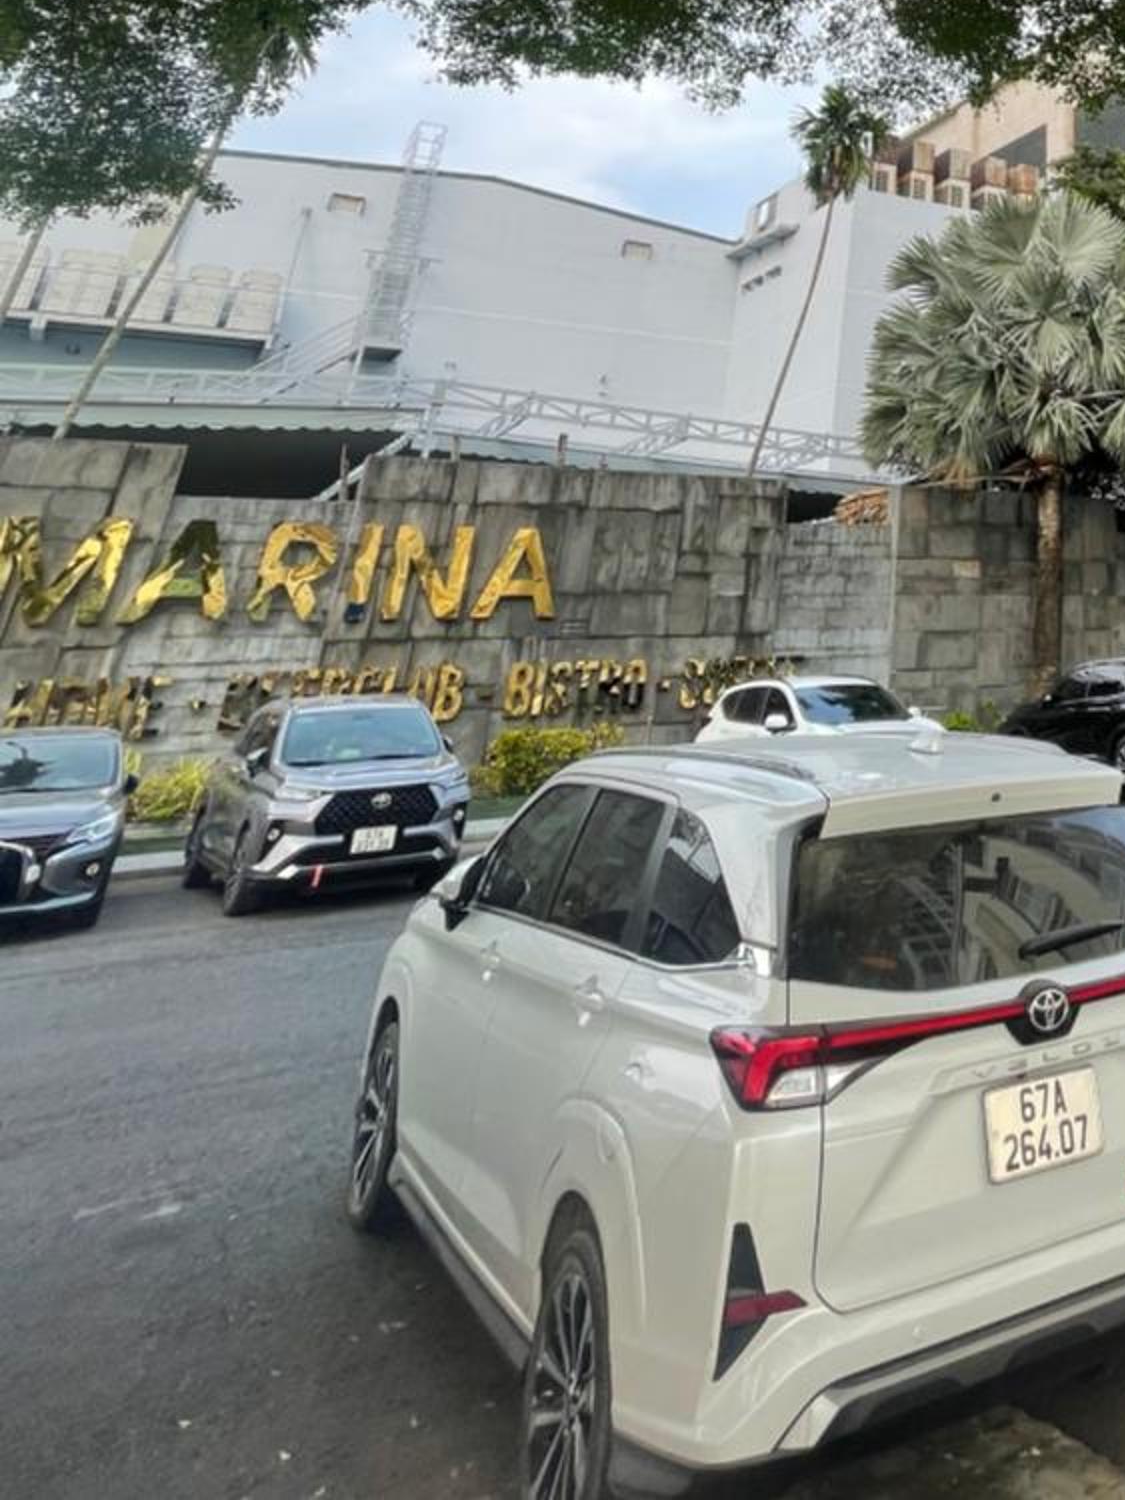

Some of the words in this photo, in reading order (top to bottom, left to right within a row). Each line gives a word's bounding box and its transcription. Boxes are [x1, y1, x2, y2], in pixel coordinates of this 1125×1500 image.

[0, 515, 557, 627] MARINA
[503, 657, 649, 718] BISTRO
[1019, 1078, 1068, 1124] 67A
[1003, 1114, 1089, 1174] 264.07
